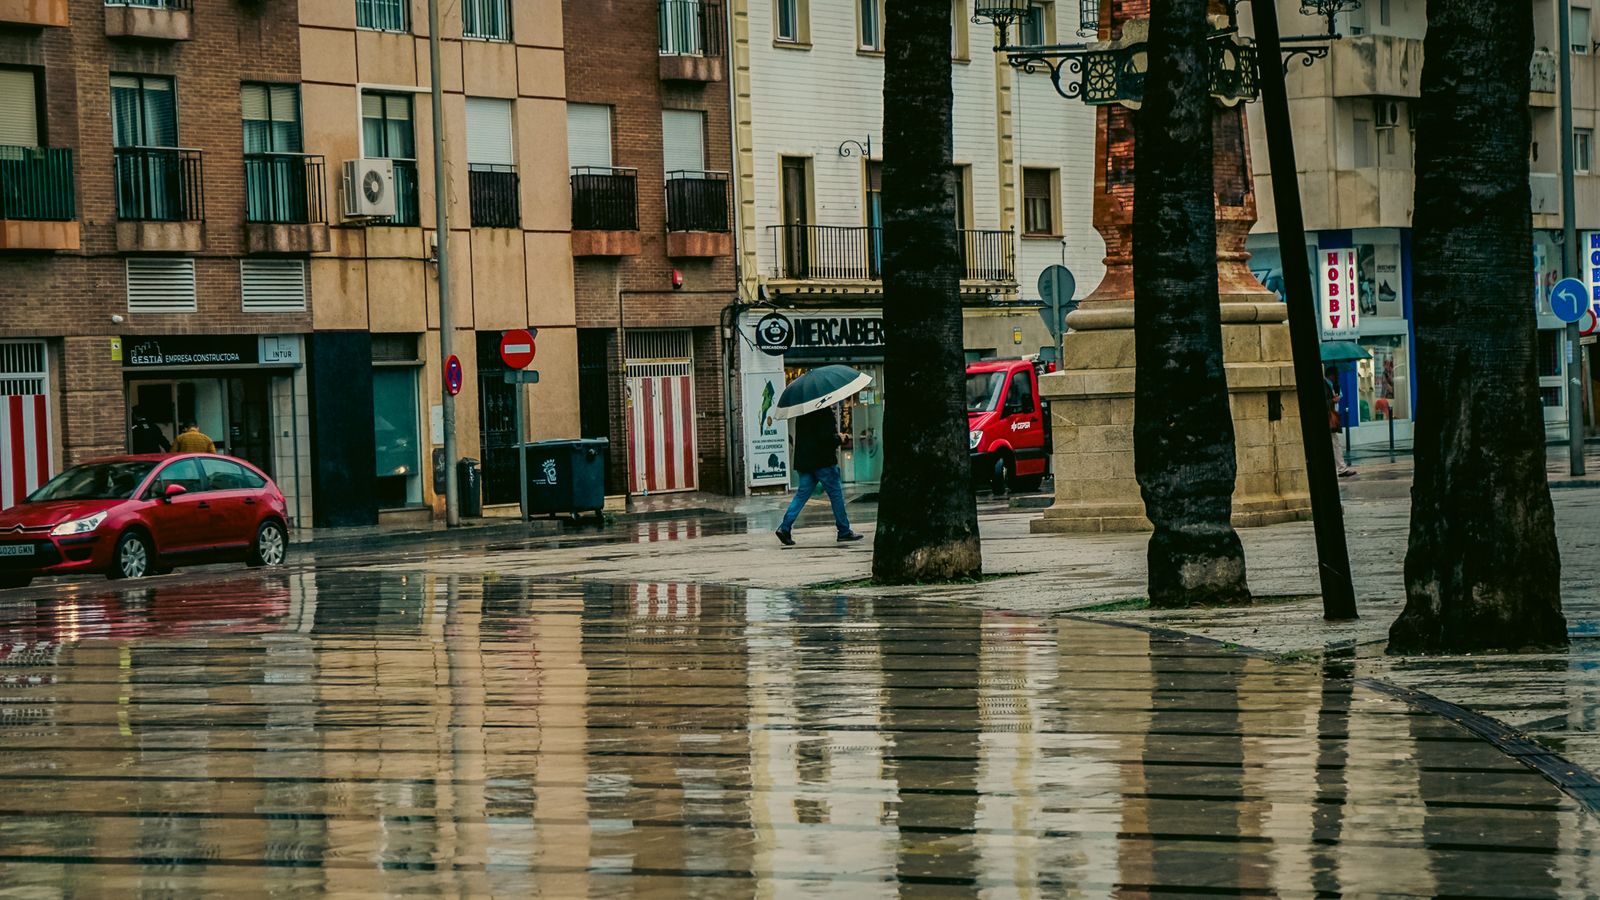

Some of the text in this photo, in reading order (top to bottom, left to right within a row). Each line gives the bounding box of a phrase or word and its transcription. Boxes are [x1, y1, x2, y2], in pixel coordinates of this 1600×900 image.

[1327, 252, 1340, 328] HOBBY
[1348, 251, 1356, 328] HOBBY
[131, 353, 240, 364] GESTIA EMPRESA CONSTRUCTORA
